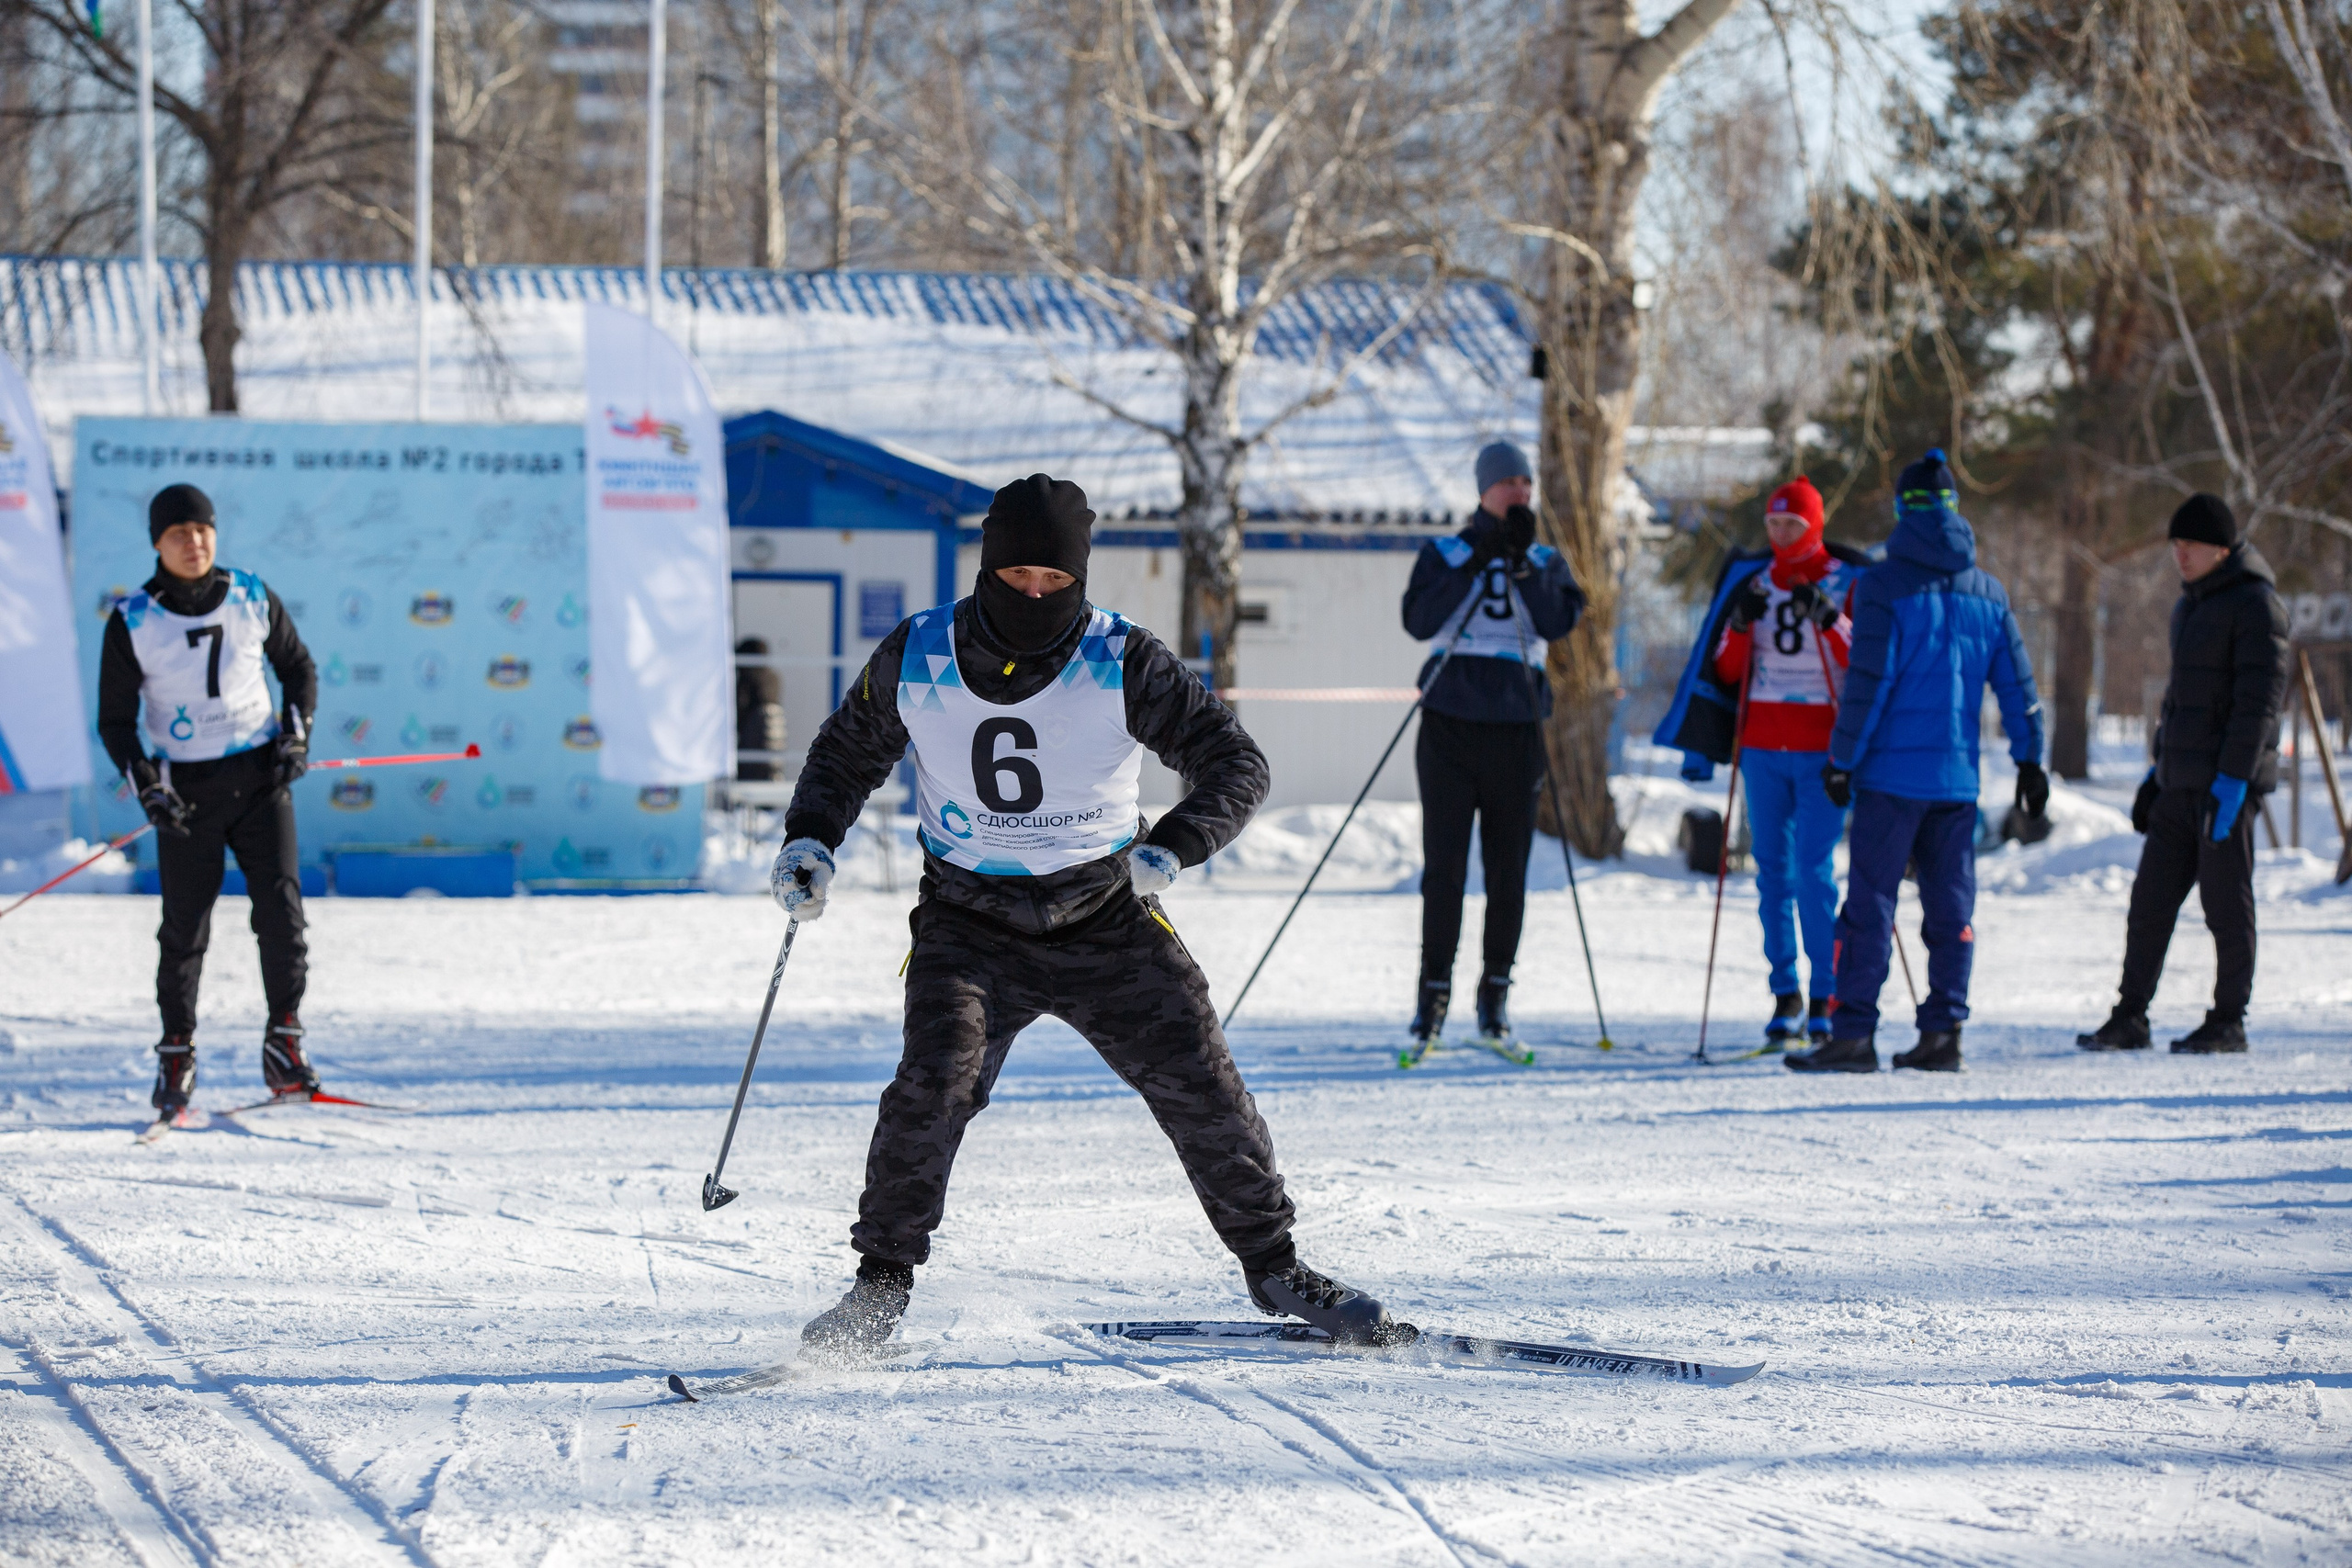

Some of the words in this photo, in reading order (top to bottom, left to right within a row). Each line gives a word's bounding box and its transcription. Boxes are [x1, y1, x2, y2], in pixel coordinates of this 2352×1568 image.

[91, 439, 275, 472] Спортивная
[294, 447, 391, 472] школа
[400, 445, 449, 472] №2
[460, 450, 563, 479] города
[1483, 567, 1513, 620] 9
[1774, 602, 1804, 656] 8
[186, 625, 223, 700] 7
[971, 716, 1044, 814] 6
[977, 813, 1073, 829] СДЮСШОР
[1078, 808, 1102, 823] №2
[1029, 841, 1056, 852] резерва
[1523, 1354, 1553, 1362] SYSTEM
